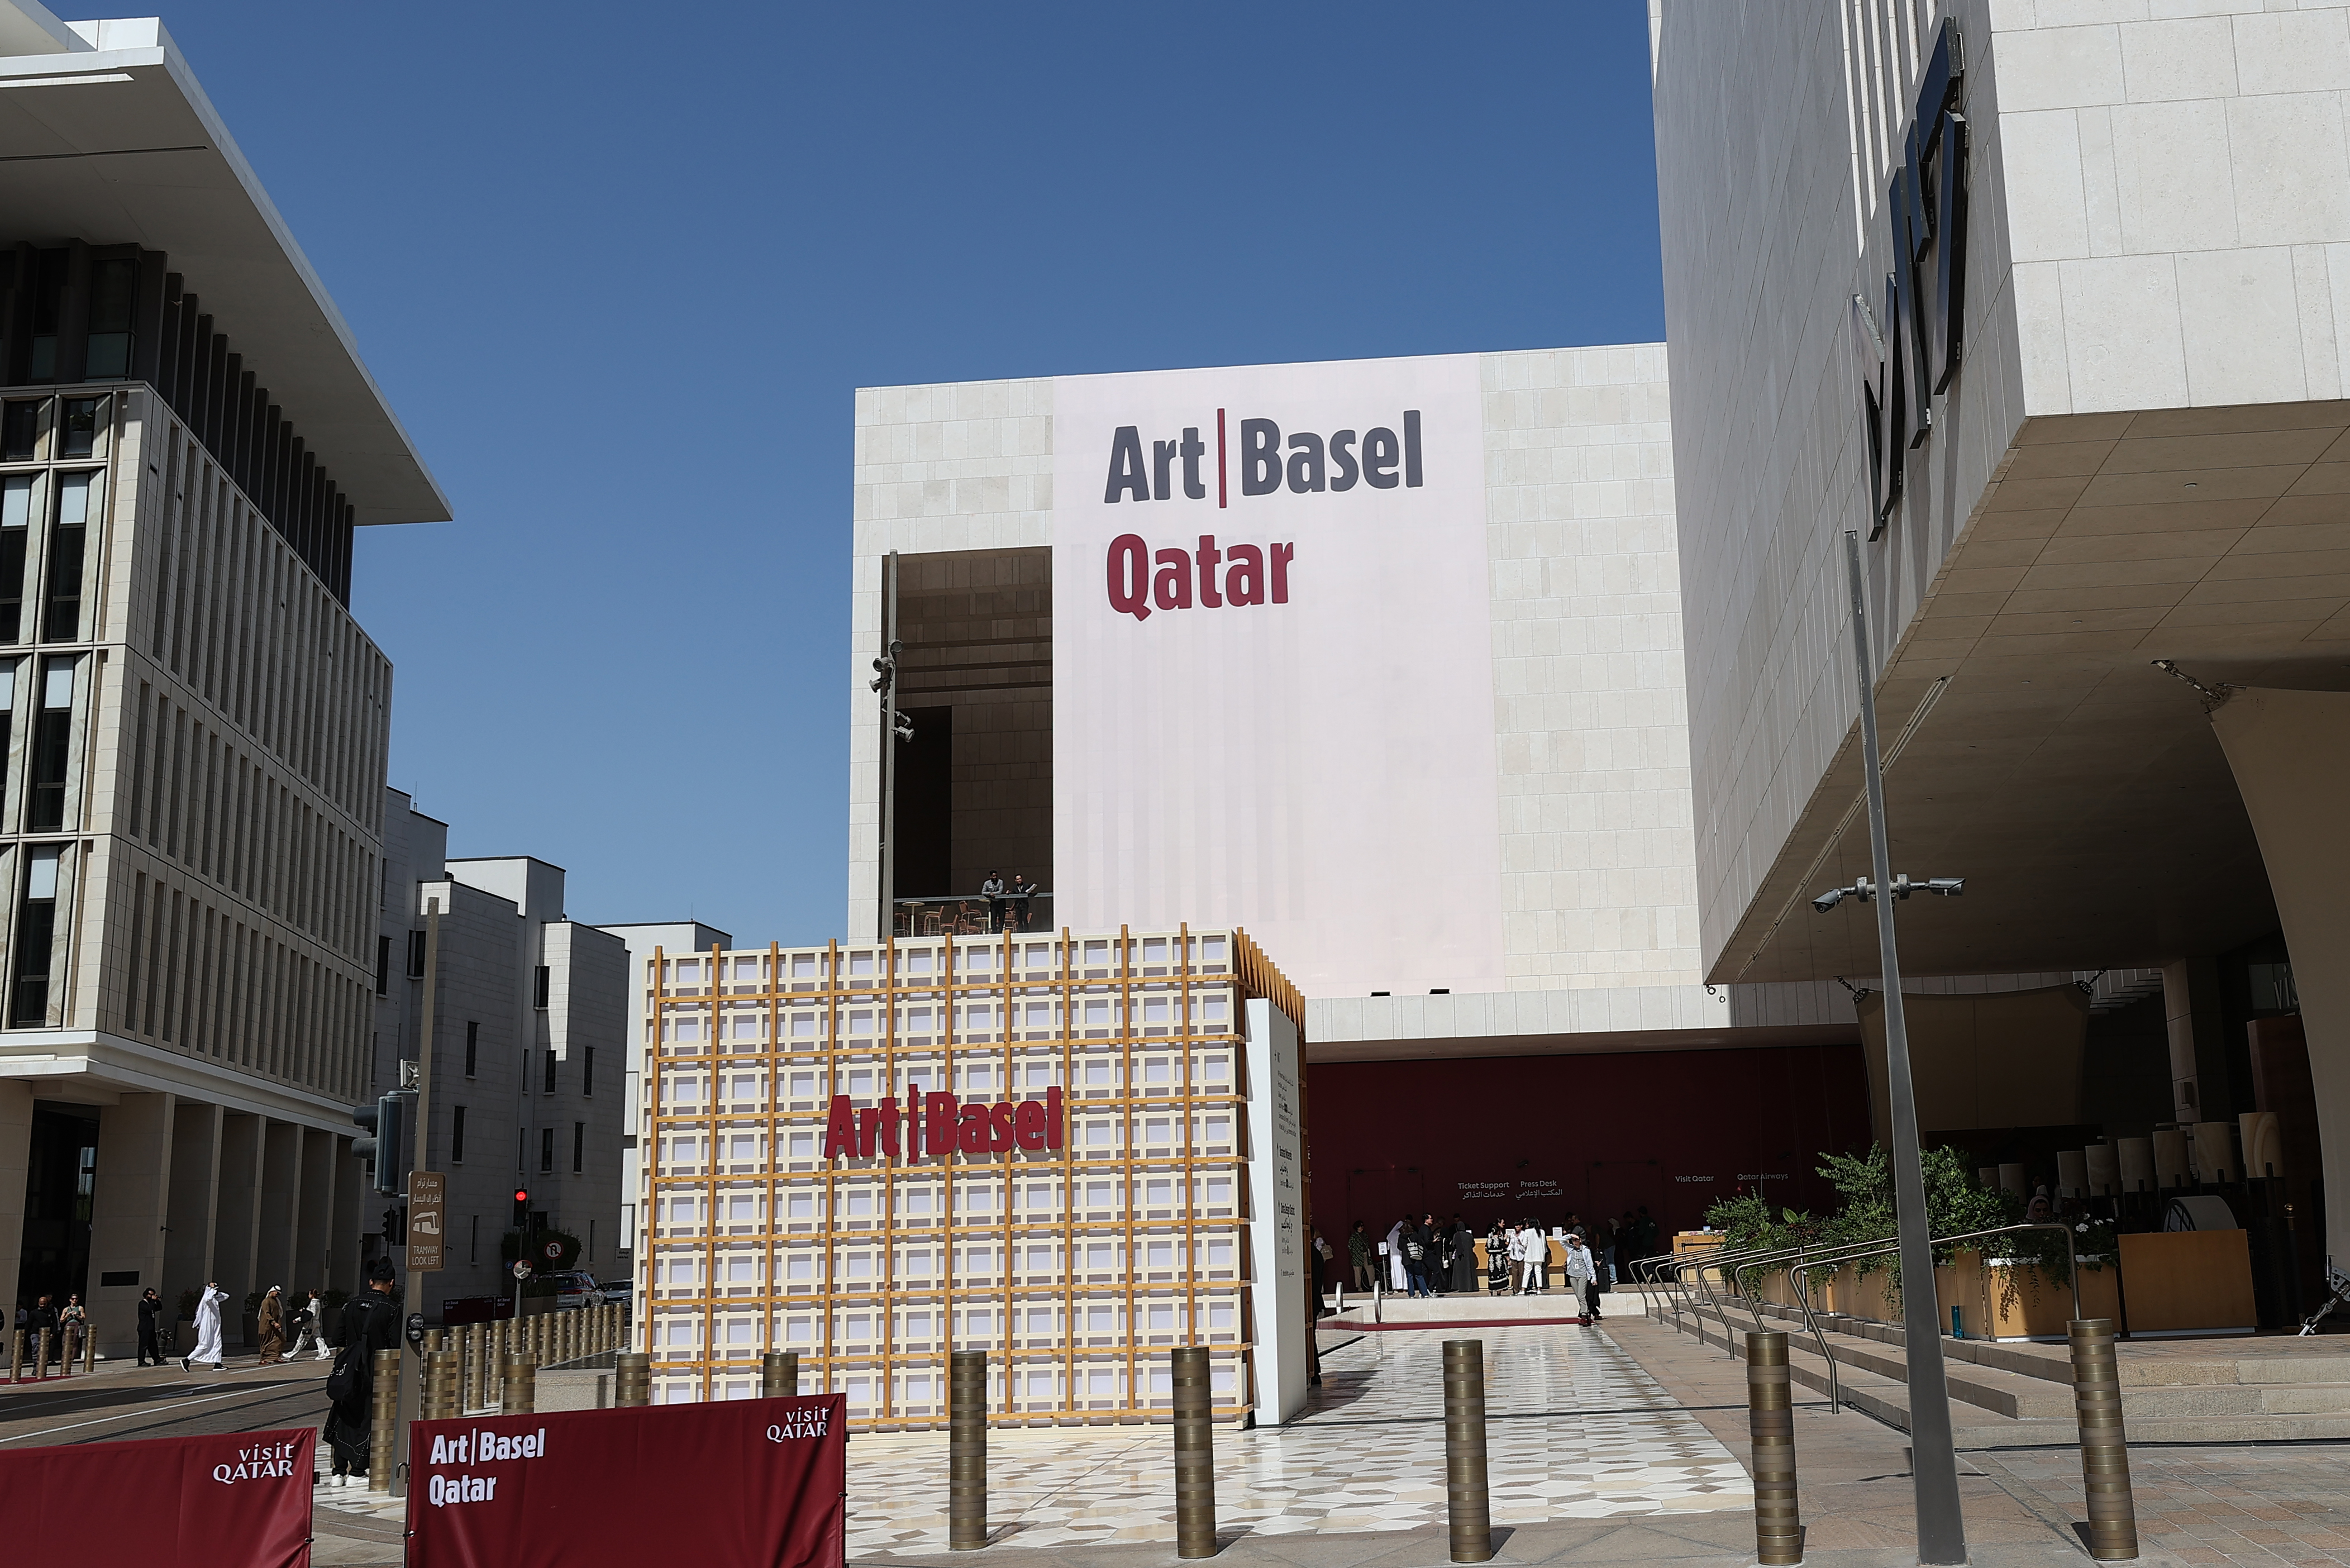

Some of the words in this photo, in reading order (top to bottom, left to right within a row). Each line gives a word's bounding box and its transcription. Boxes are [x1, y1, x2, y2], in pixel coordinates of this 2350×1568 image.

[1104, 425, 1205, 503] Art
[1241, 409, 1423, 497] Basel
[1107, 533, 1294, 621] Qatar
[823, 1094, 899, 1159] Art
[926, 1085, 1061, 1155] Basel
[1480, 1181, 1510, 1190] Support
[1760, 1173, 1789, 1181] Airways
[1462, 1191, 1483, 1200] التذاكر
[1541, 1189, 1563, 1198] المكتب
[413, 1245, 438, 1255] TRAMWAY
[412, 1256, 427, 1266] LOOK
[428, 1256, 439, 1265] LEFT
[786, 1405, 830, 1423] visit
[766, 1422, 827, 1443] QATAR
[239, 1442, 294, 1462] visit
[430, 1434, 468, 1464] Art
[479, 1428, 545, 1462] Basel
[213, 1460, 293, 1484] QATAR
[429, 1474, 497, 1508] Qatar
